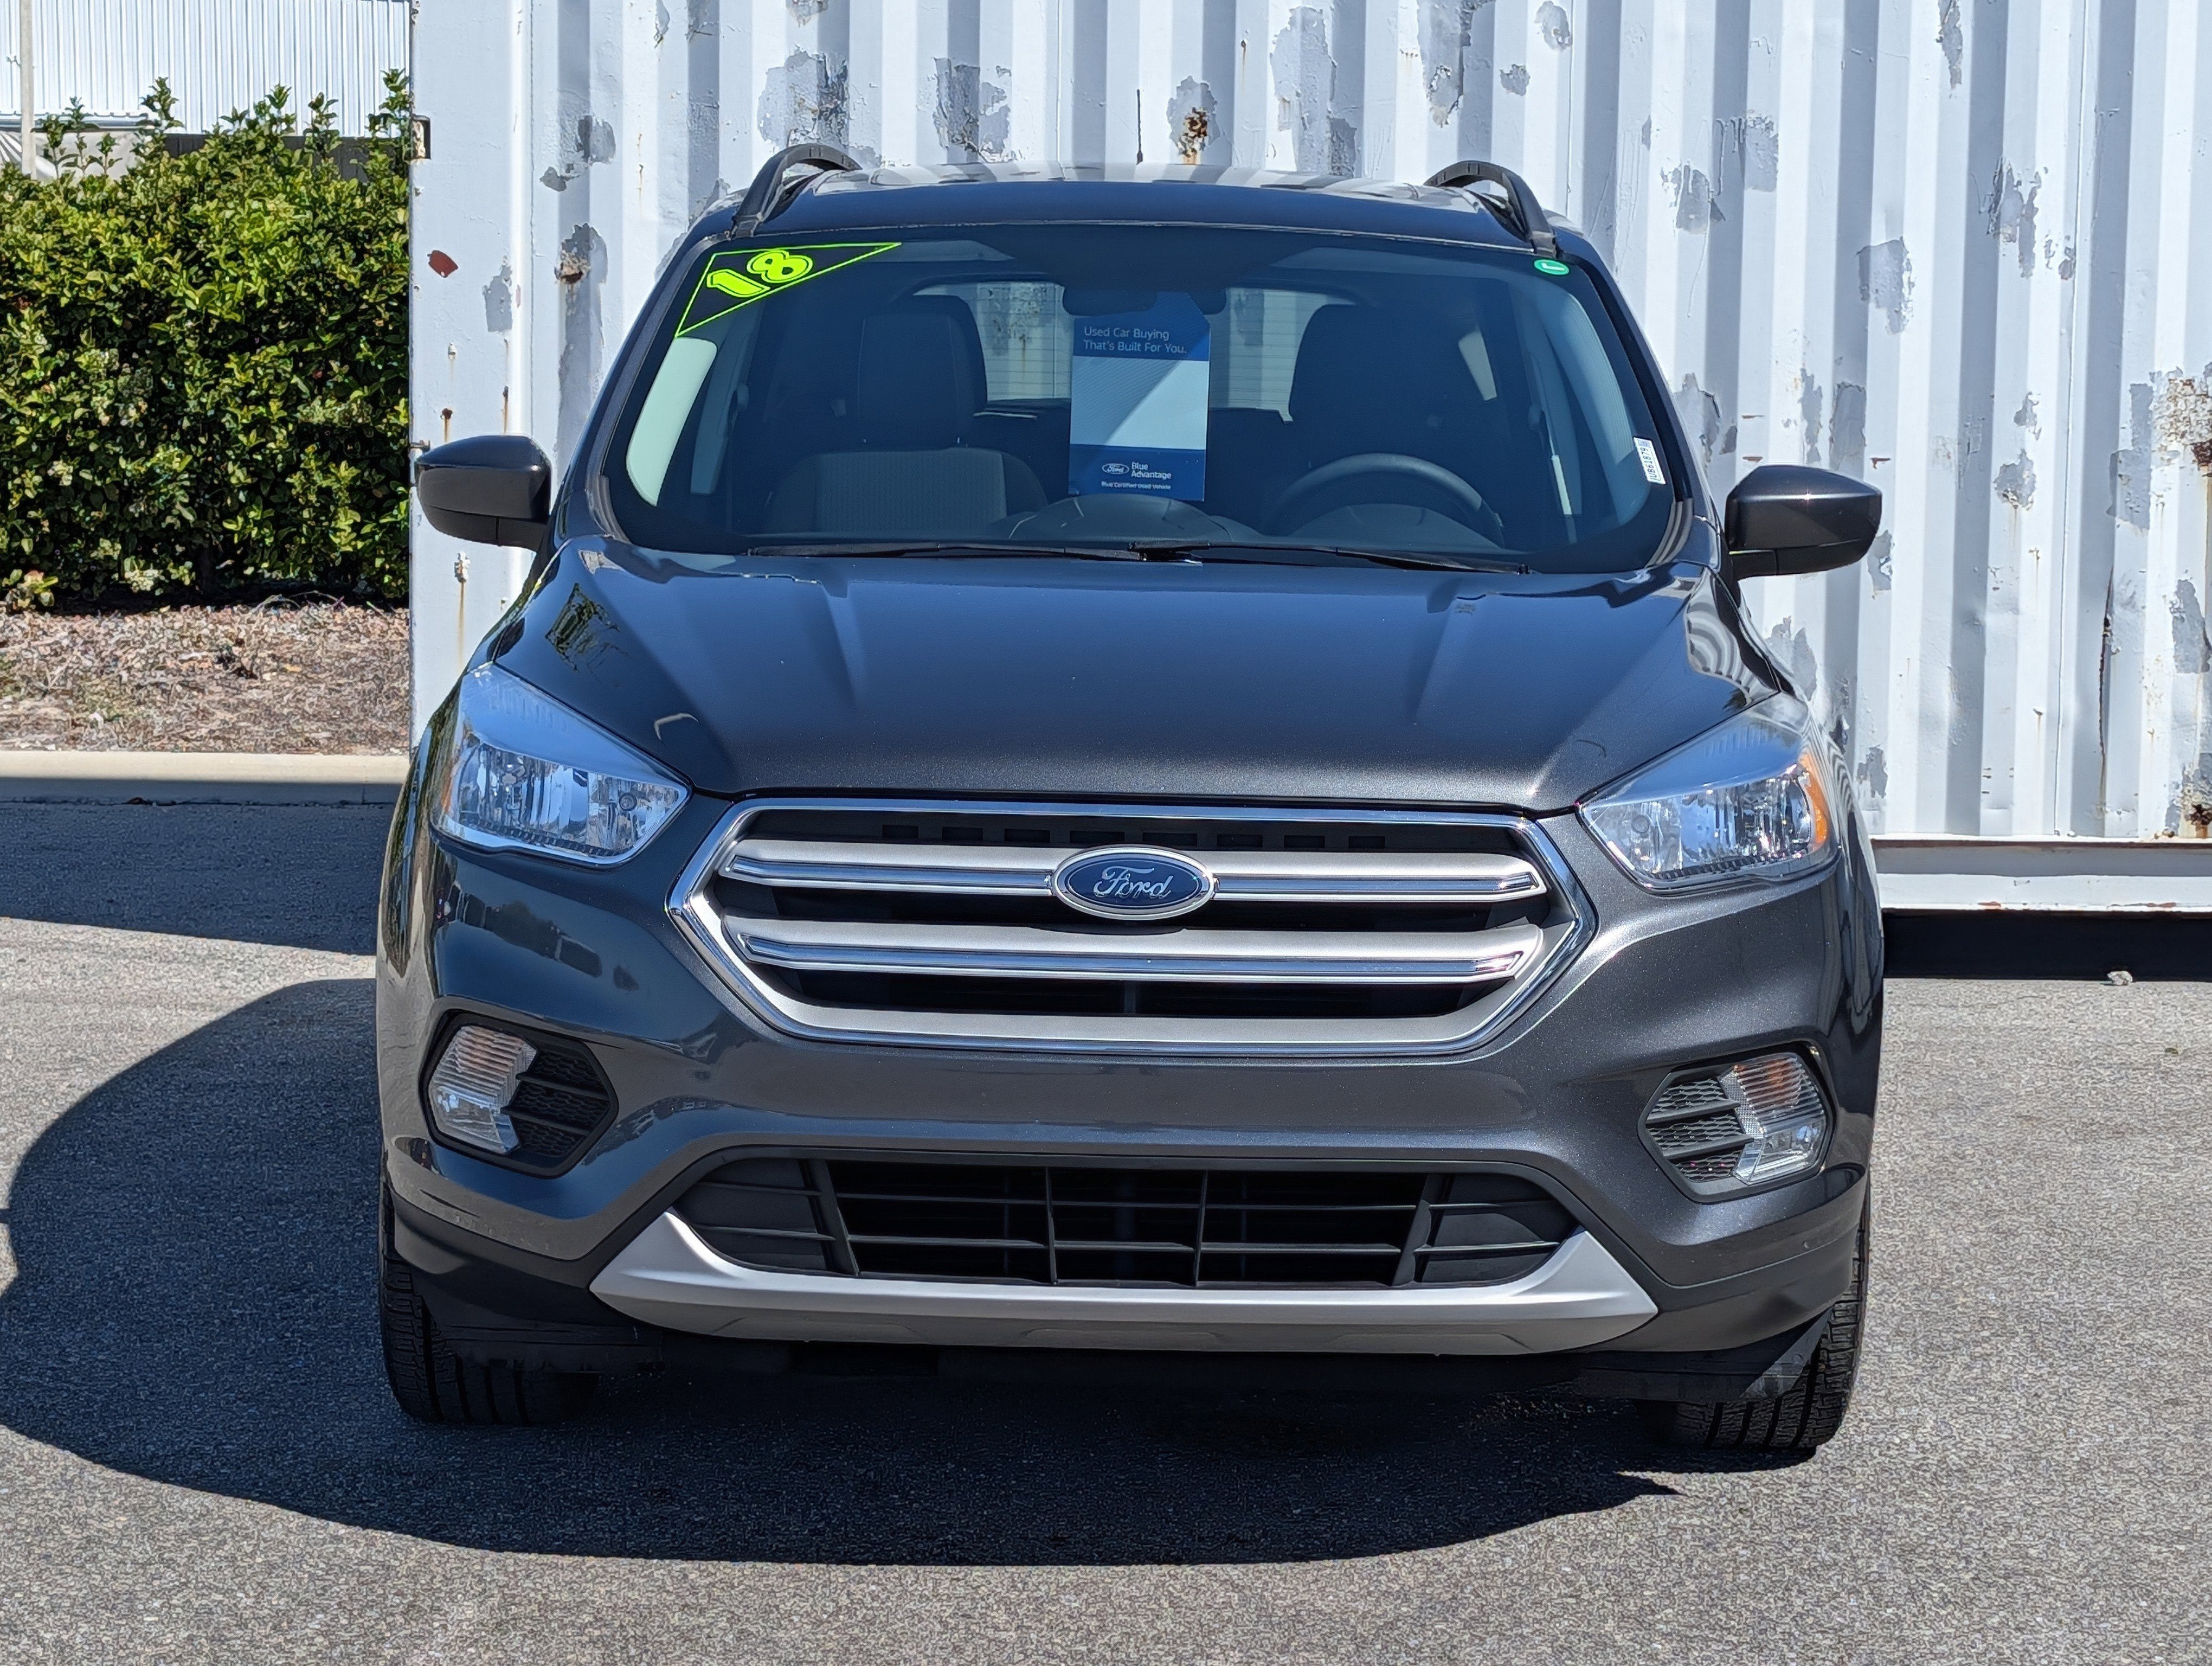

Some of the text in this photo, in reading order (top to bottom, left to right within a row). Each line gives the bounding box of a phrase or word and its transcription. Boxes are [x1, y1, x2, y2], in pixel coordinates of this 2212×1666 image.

[706, 249, 813, 298] 18
[1084, 326, 1169, 341] Used Car Buying
[1084, 339, 1187, 354] That's Built For You.
[1131, 462, 1148, 470] Blue
[1131, 470, 1172, 480] Advantage
[1094, 866, 1173, 899] Ford
